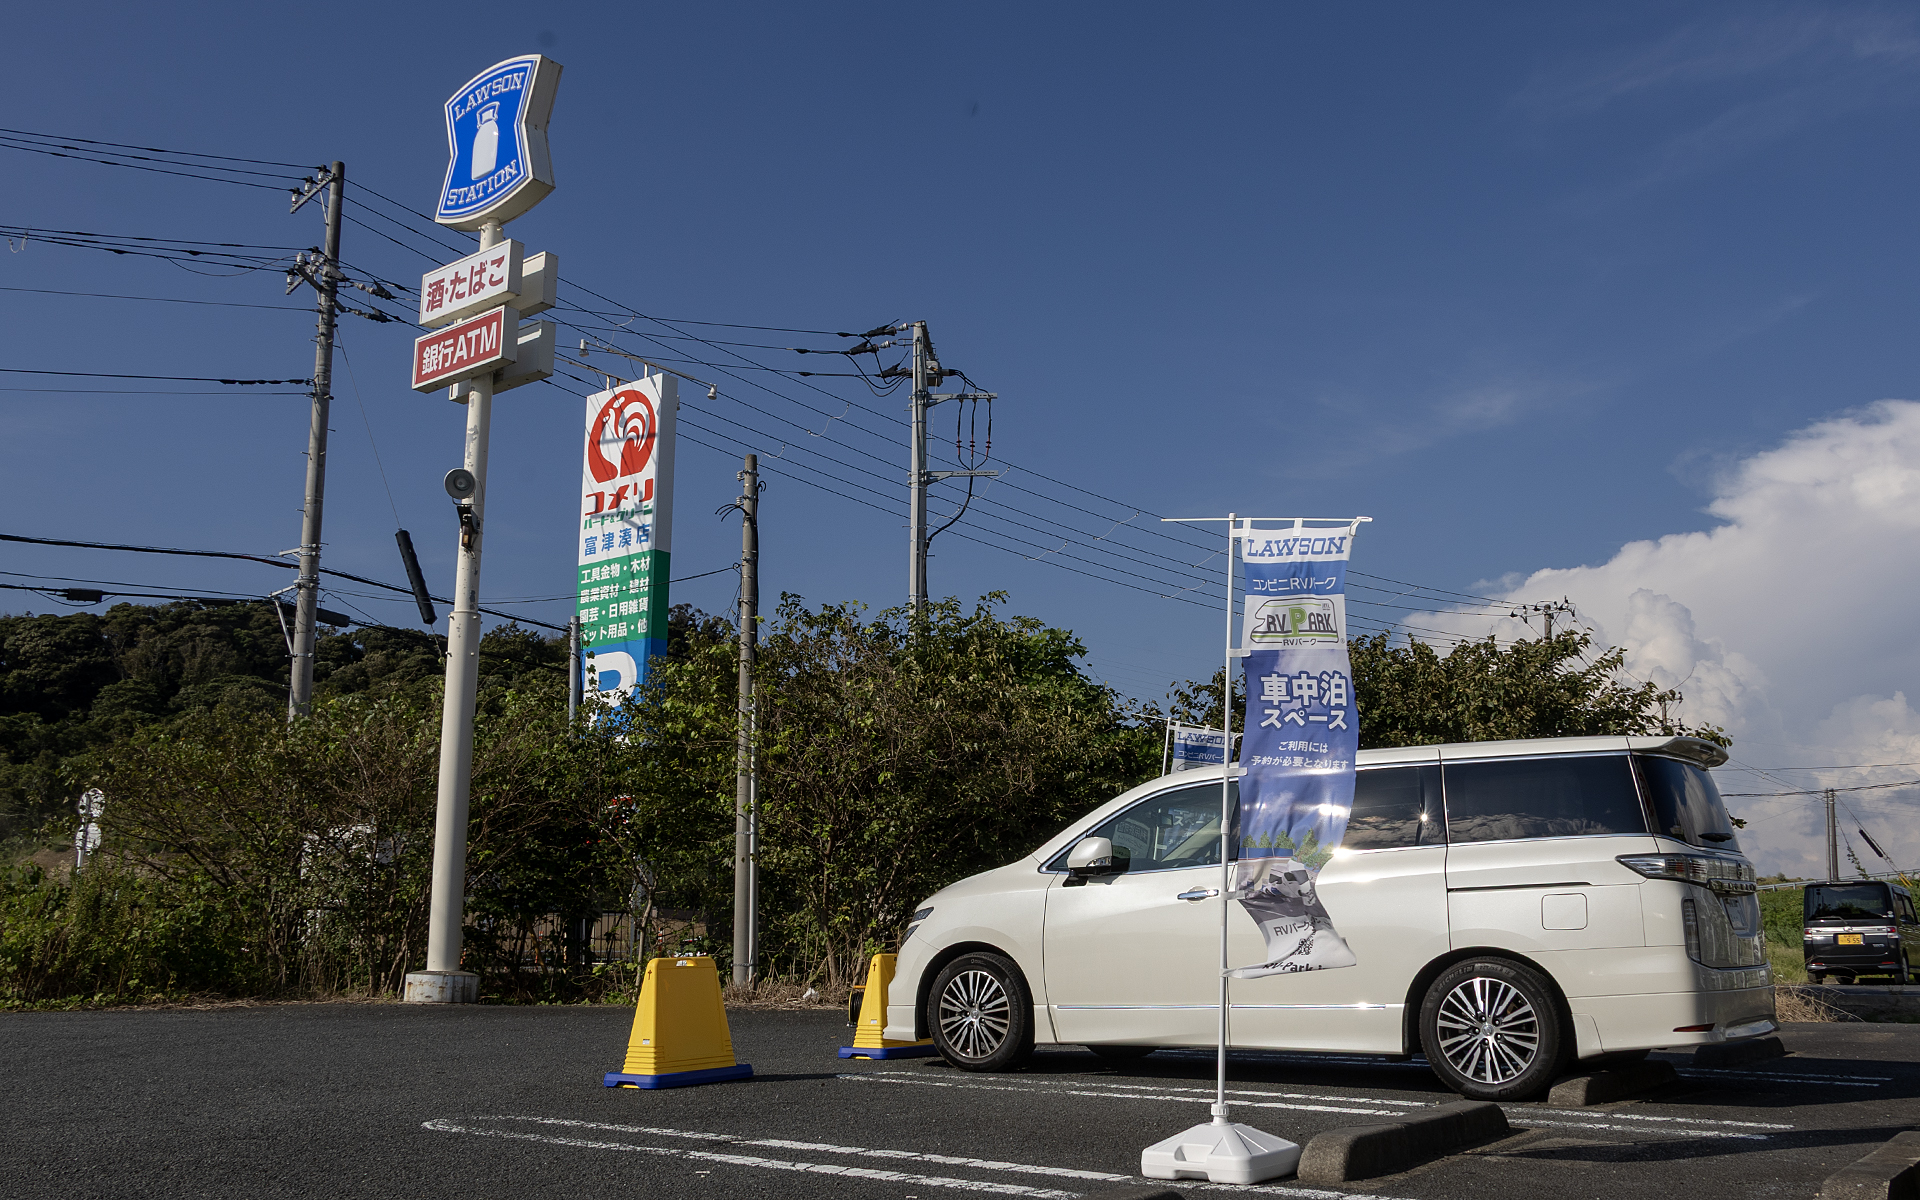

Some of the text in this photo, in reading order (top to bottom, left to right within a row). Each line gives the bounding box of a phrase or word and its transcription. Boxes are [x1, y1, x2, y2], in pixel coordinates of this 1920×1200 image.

[454, 72, 525, 121] LAWSON
[447, 159, 518, 205] STATION
[426, 254, 505, 313] 酒・たばこ
[422, 321, 497, 375] 銀行ATM
[585, 478, 654, 516] コメリ
[584, 523, 651, 557] 富津湊店
[1247, 536, 1347, 557] LAWSON
[1252, 576, 1337, 592] コンビニRVパーク
[1283, 638, 1318, 646] RVパーク
[583, 651, 638, 731] P
[1259, 671, 1348, 707] 車中泊
[1259, 708, 1348, 731] スペース
[1250, 755, 1349, 770] 予約が必要となります
[1278, 740, 1329, 753] ご利用には
